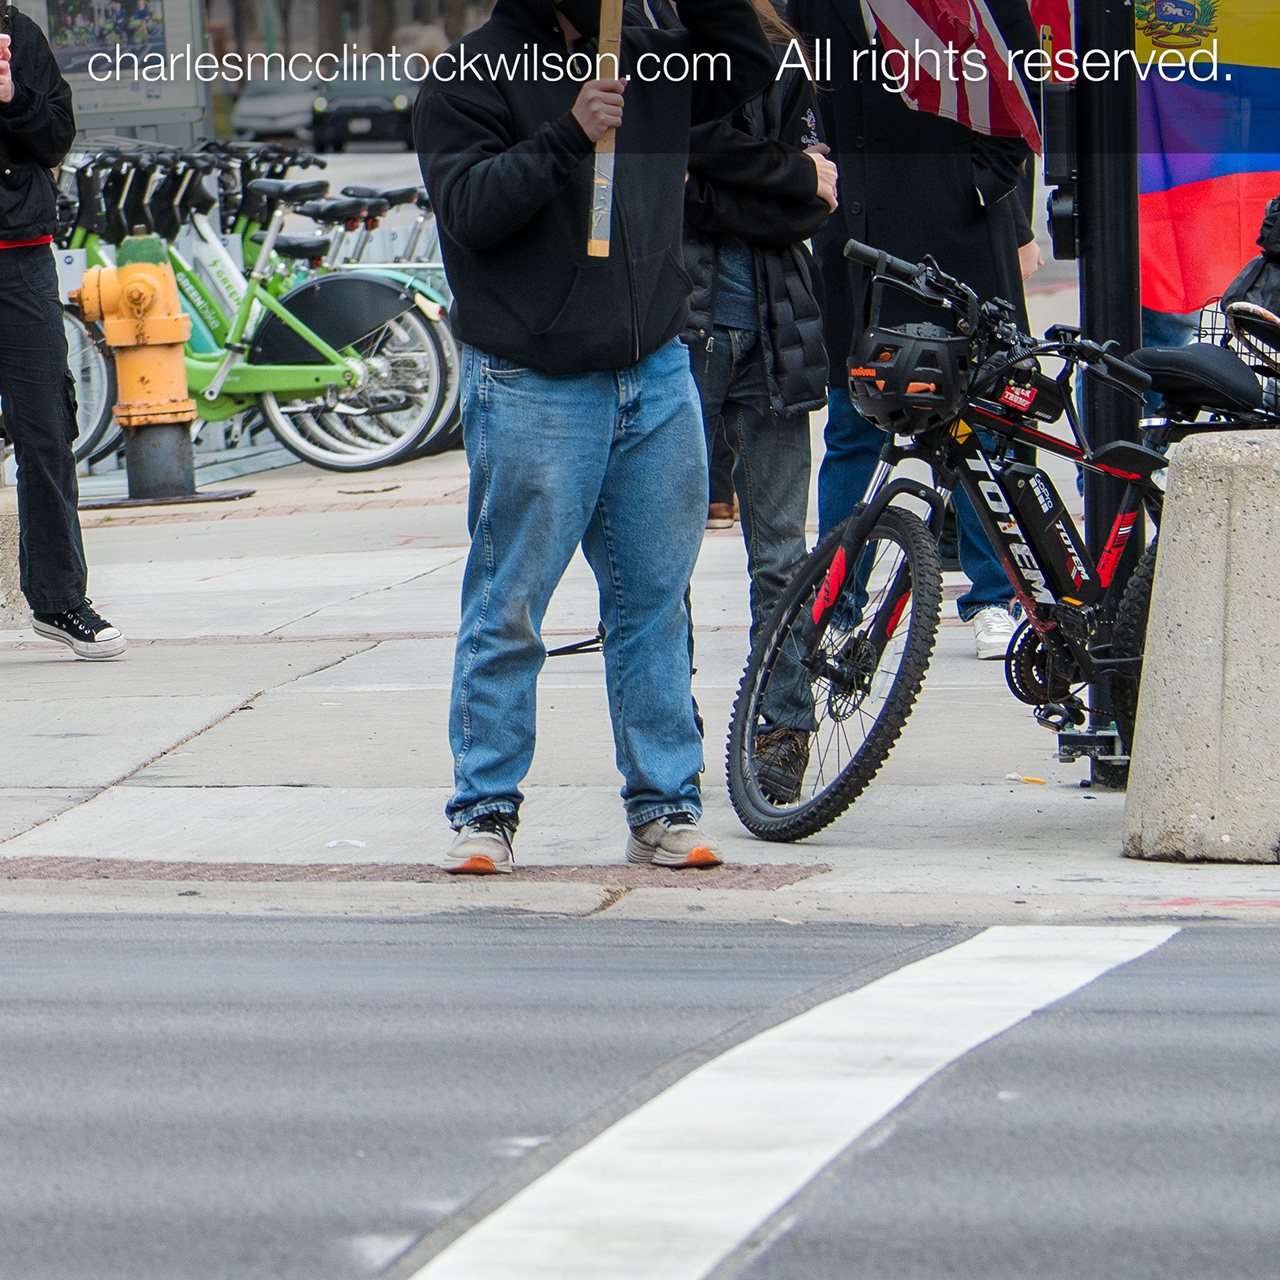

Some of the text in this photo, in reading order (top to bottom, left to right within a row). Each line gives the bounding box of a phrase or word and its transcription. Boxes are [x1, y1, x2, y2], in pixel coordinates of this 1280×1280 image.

[1004, 391, 1030, 407] TRUMP
[1034, 473, 1054, 509] GoPro
[965, 449, 1057, 605] TOTEM
[1054, 520, 1091, 581] TOTEM
